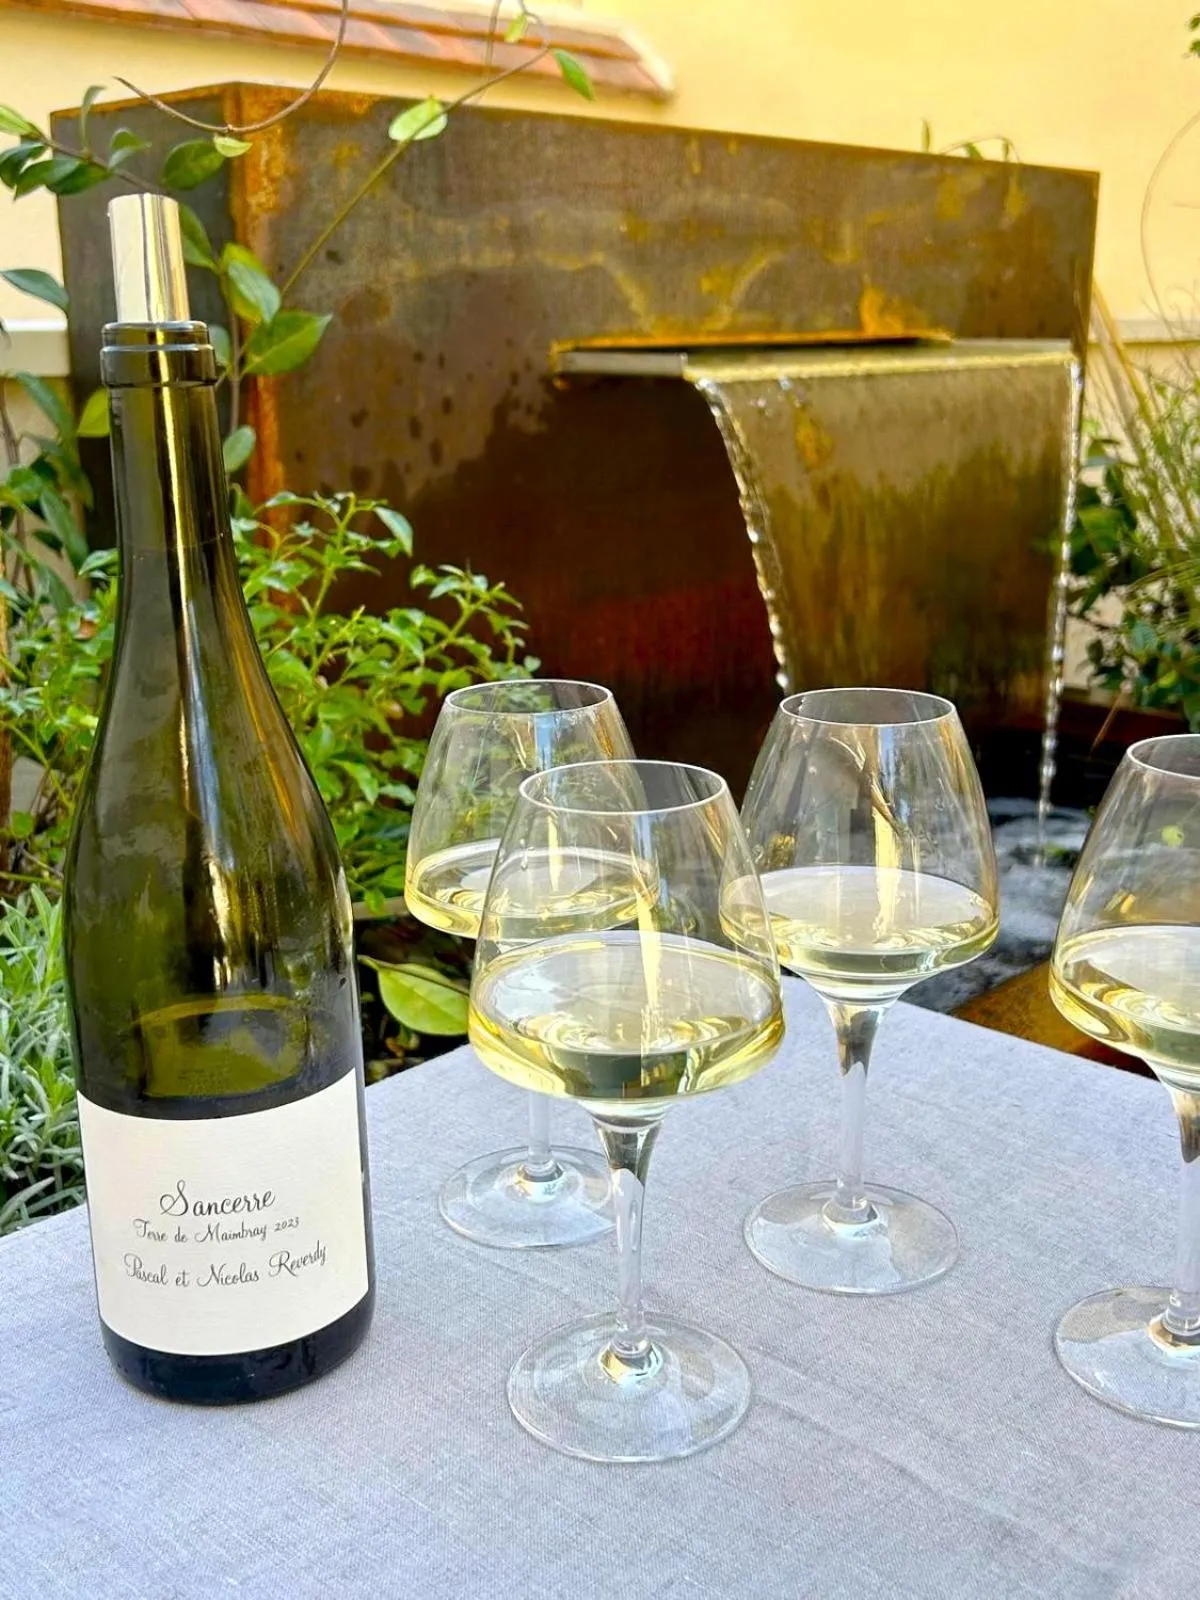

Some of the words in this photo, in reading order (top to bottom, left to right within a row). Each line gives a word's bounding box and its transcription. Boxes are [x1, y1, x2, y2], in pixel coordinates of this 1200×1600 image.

[159, 1179, 275, 1217] Sancerre
[133, 1218, 168, 1242] Terre
[174, 1226, 188, 1243] de
[195, 1222, 267, 1243] Maimbray
[274, 1216, 300, 1232] 2023
[123, 1252, 168, 1286] Pascal
[175, 1271, 190, 1287] et
[197, 1263, 260, 1287] Nicolas
[268, 1240, 327, 1279] Reverdy
